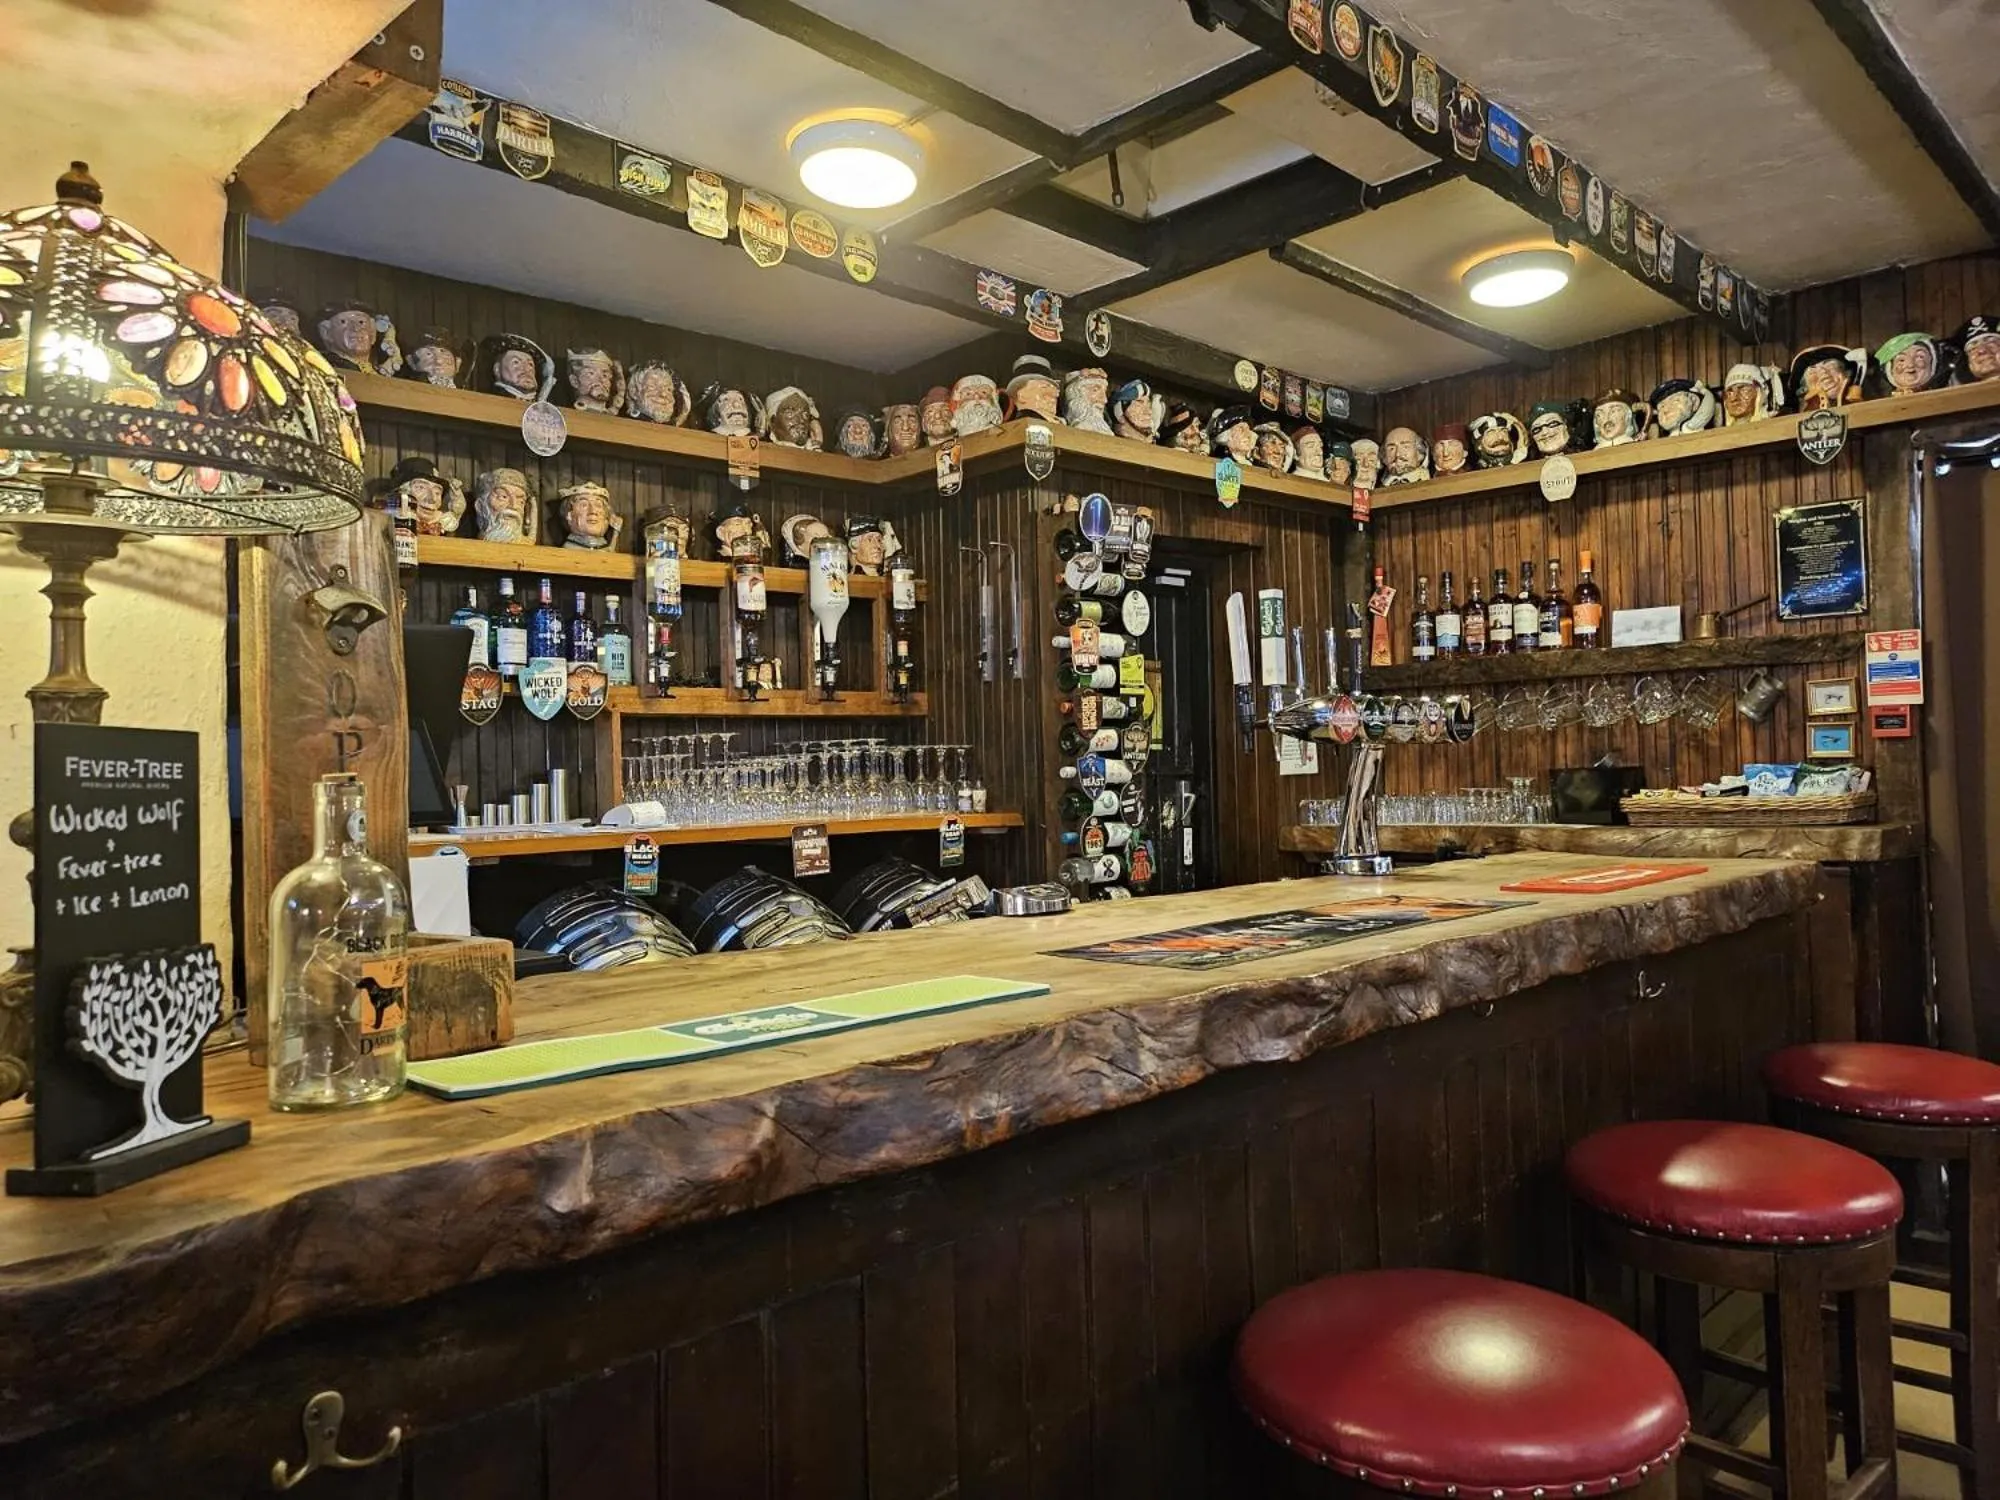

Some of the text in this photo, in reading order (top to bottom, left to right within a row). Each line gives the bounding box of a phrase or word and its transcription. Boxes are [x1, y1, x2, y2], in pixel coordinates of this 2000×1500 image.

[1801, 438, 1841, 450] ANTLER
[525, 676, 562, 689] WICKED
[531, 687, 558, 699] WOLF
[462, 699, 497, 710] STAG
[569, 696, 604, 707] GOLD
[49, 803, 128, 835] Wicked
[624, 843, 660, 853] BLACK
[129, 882, 189, 908] Lemon
[347, 935, 386, 953] BLACK
